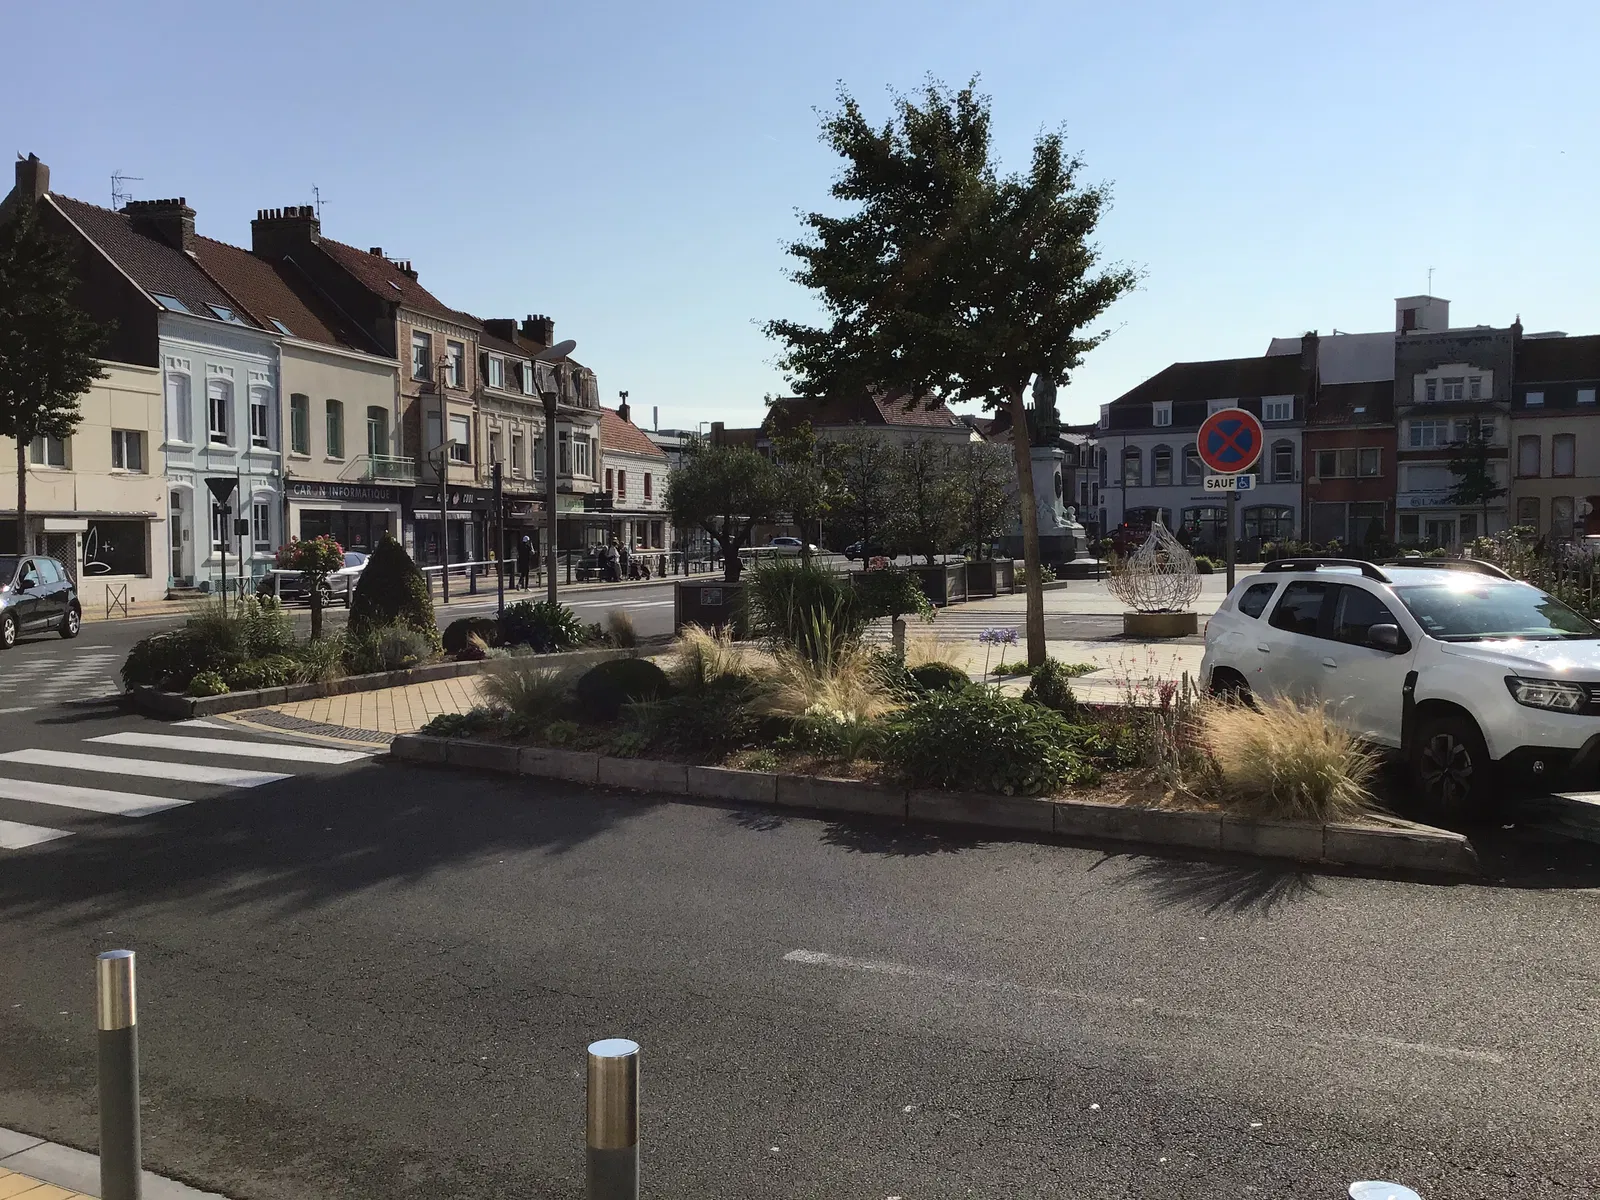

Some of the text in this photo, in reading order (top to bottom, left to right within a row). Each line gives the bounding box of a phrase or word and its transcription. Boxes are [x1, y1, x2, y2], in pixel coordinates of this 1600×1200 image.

[1207, 478, 1235, 488] SAUF
[293, 484, 390, 499] CARON INFORMATIQUE
